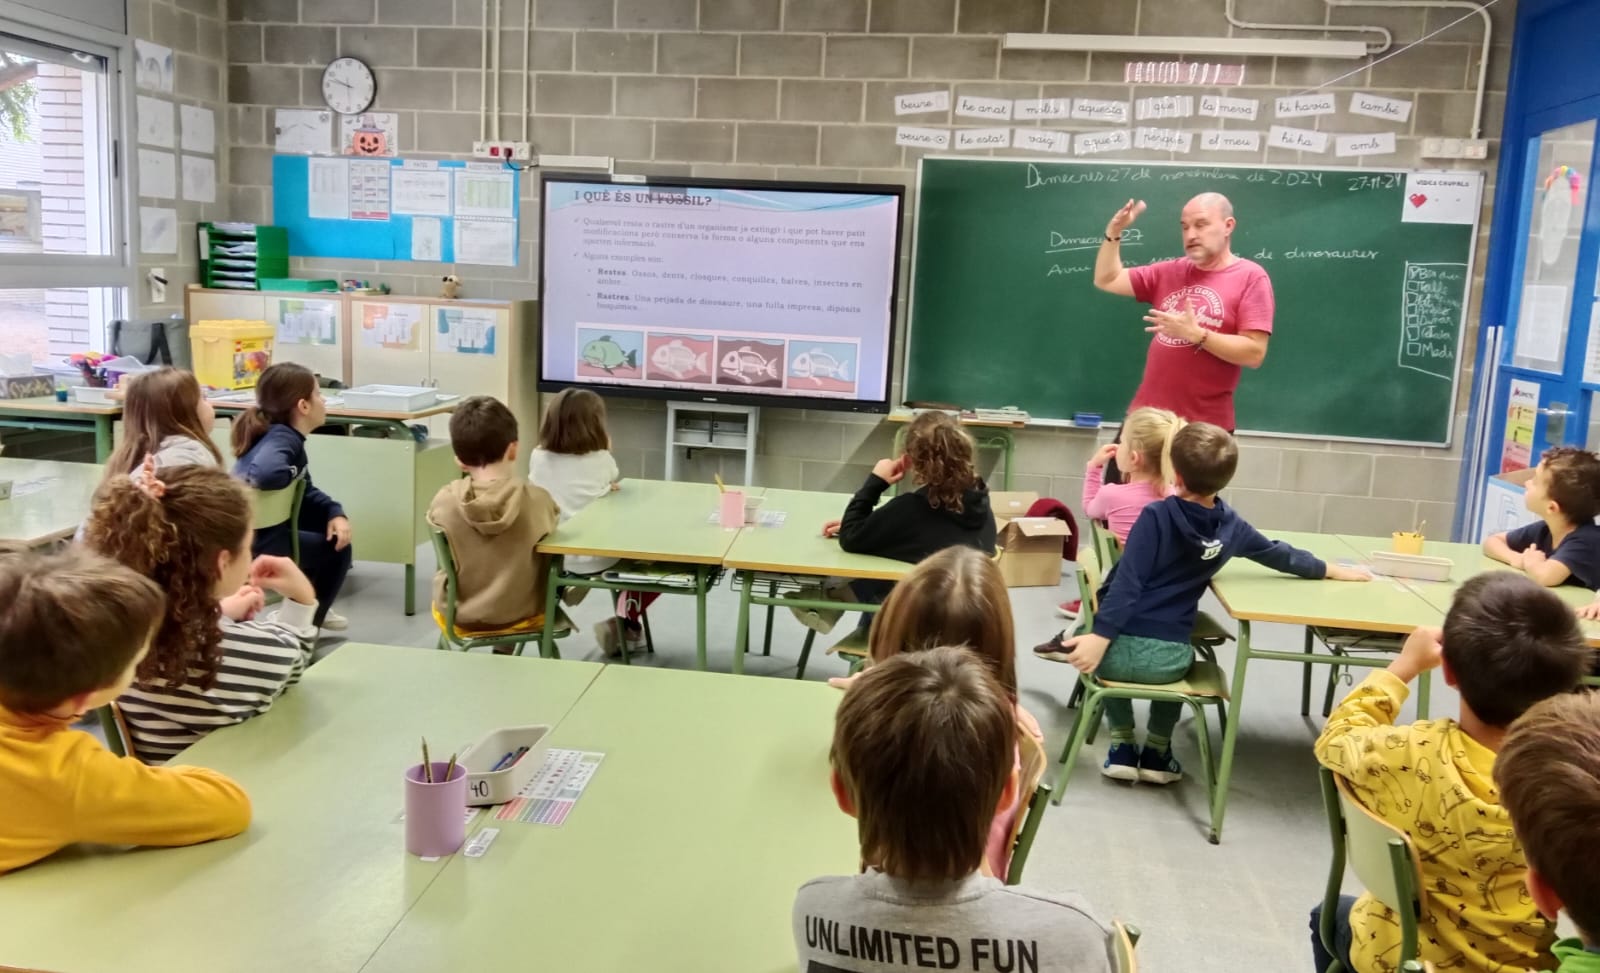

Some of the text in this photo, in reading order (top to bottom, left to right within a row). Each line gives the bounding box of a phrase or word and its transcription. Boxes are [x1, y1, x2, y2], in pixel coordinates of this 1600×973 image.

[900, 99, 934, 109] beure
[962, 99, 1006, 114] he anat
[1202, 99, 1253, 114] la meva
[1279, 100, 1331, 112] hi havia
[1360, 100, 1400, 115] també
[899, 132, 932, 142] veure
[960, 133, 974, 144] he
[1028, 135, 1056, 148] vaig
[1208, 134, 1252, 146] el meu
[1282, 132, 1312, 146] hi ha
[1350, 137, 1380, 150] amb
[1111, 167, 1131, 182] 27
[1131, 168, 1152, 181] de
[1247, 170, 1264, 182] de
[574, 190, 580, 200] I
[584, 189, 610, 203] QUÈ
[636, 193, 653, 204] UN
[701, 232, 710, 240] la
[711, 233, 736, 242] forma
[746, 235, 775, 244] alguns
[777, 236, 829, 246] components
[788, 228, 803, 236] que
[805, 228, 818, 236] pot
[821, 228, 845, 236] haver
[846, 229, 866, 238] patit
[1120, 229, 1145, 242] 27
[1254, 248, 1273, 260] de
[1284, 246, 1379, 260] dinosaures
[687, 296, 697, 304] de
[765, 300, 785, 310] fulla
[1194, 286, 1222, 315] CLOTHING
[470, 780, 489, 798] 40
[806, 916, 1039, 973] UNLIMITED FUN
